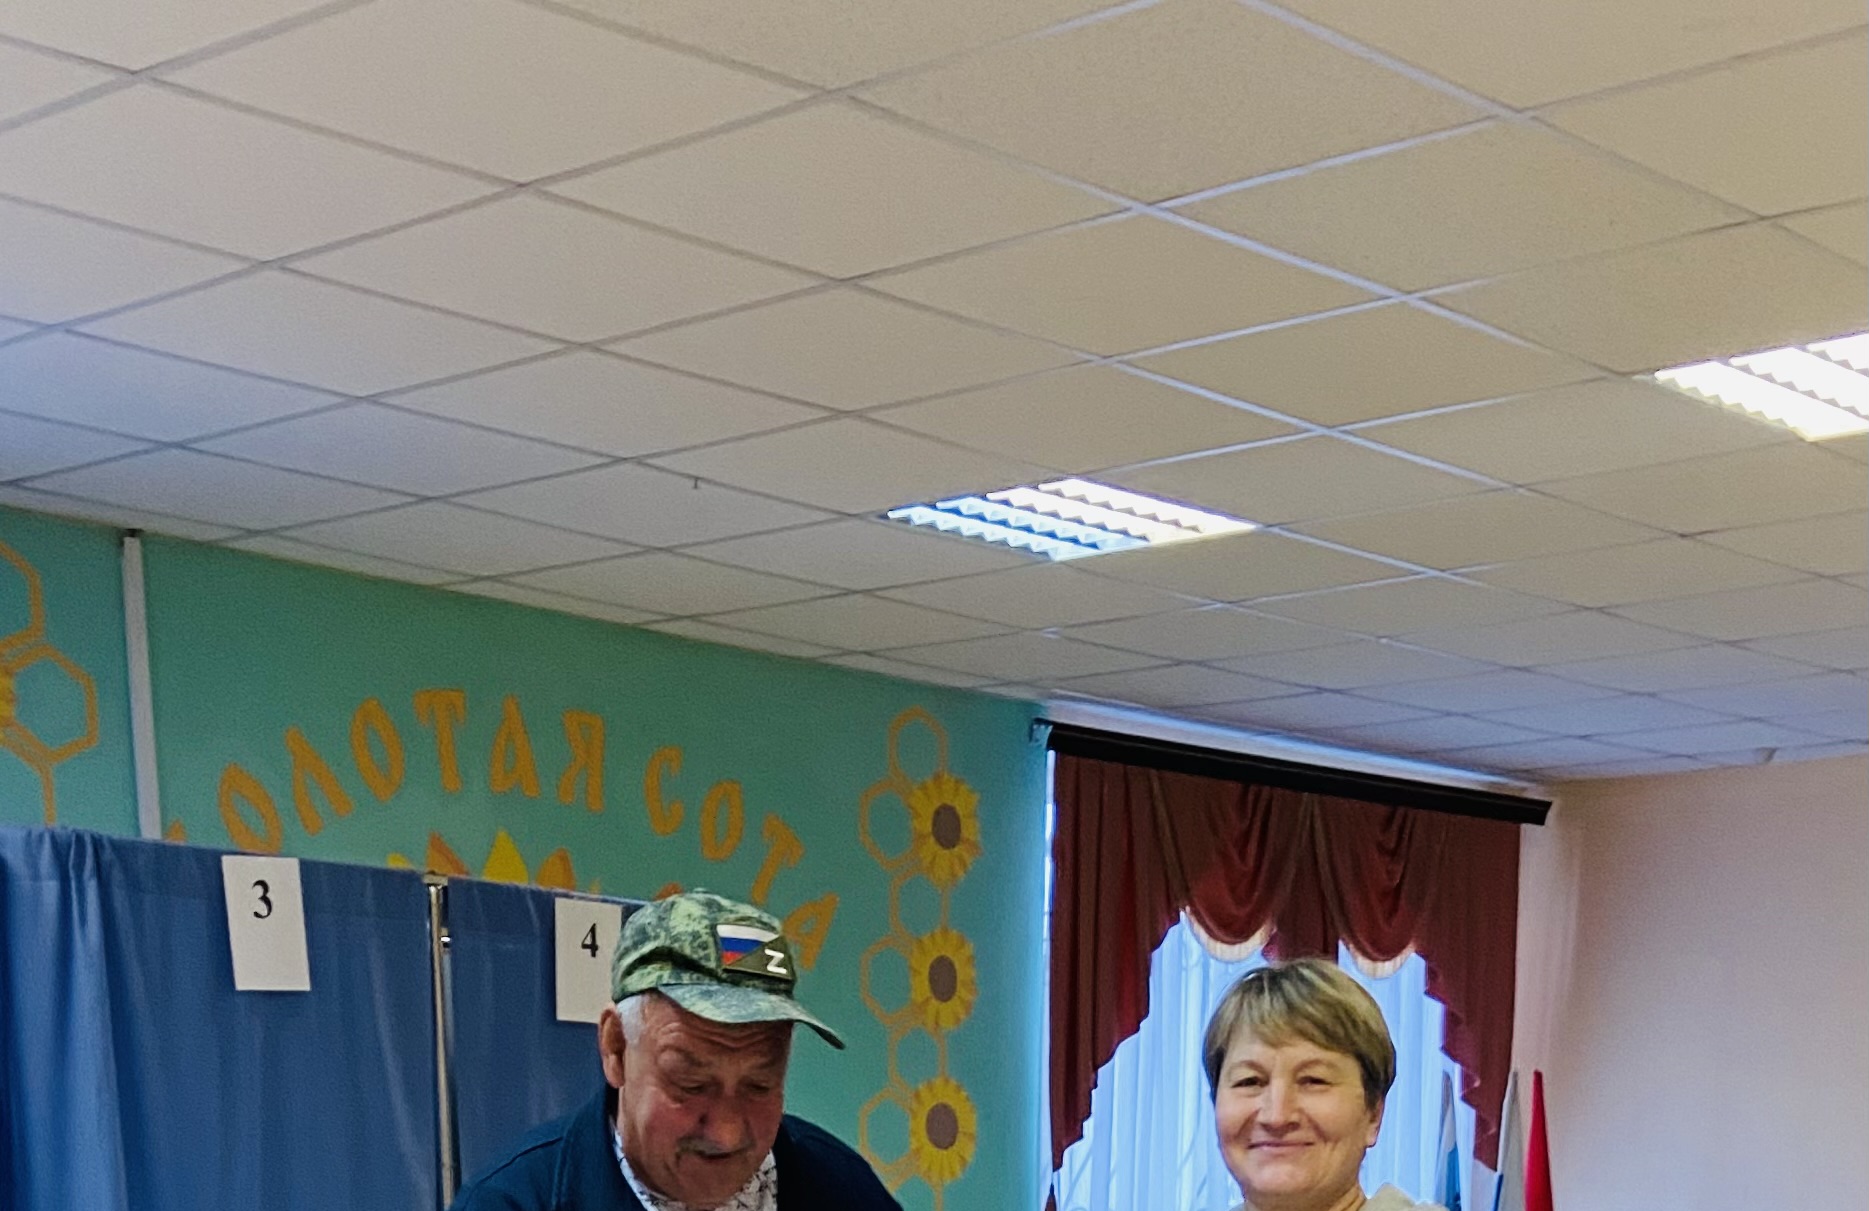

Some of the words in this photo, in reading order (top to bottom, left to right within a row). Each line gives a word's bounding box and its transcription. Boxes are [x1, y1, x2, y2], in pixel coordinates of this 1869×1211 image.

[163, 688, 605, 854] ОЛОТАЯ
[644, 745, 839, 970] СОТА
[252, 879, 273, 919] 3
[581, 922, 599, 957] 4
[764, 948, 788, 974] Z
